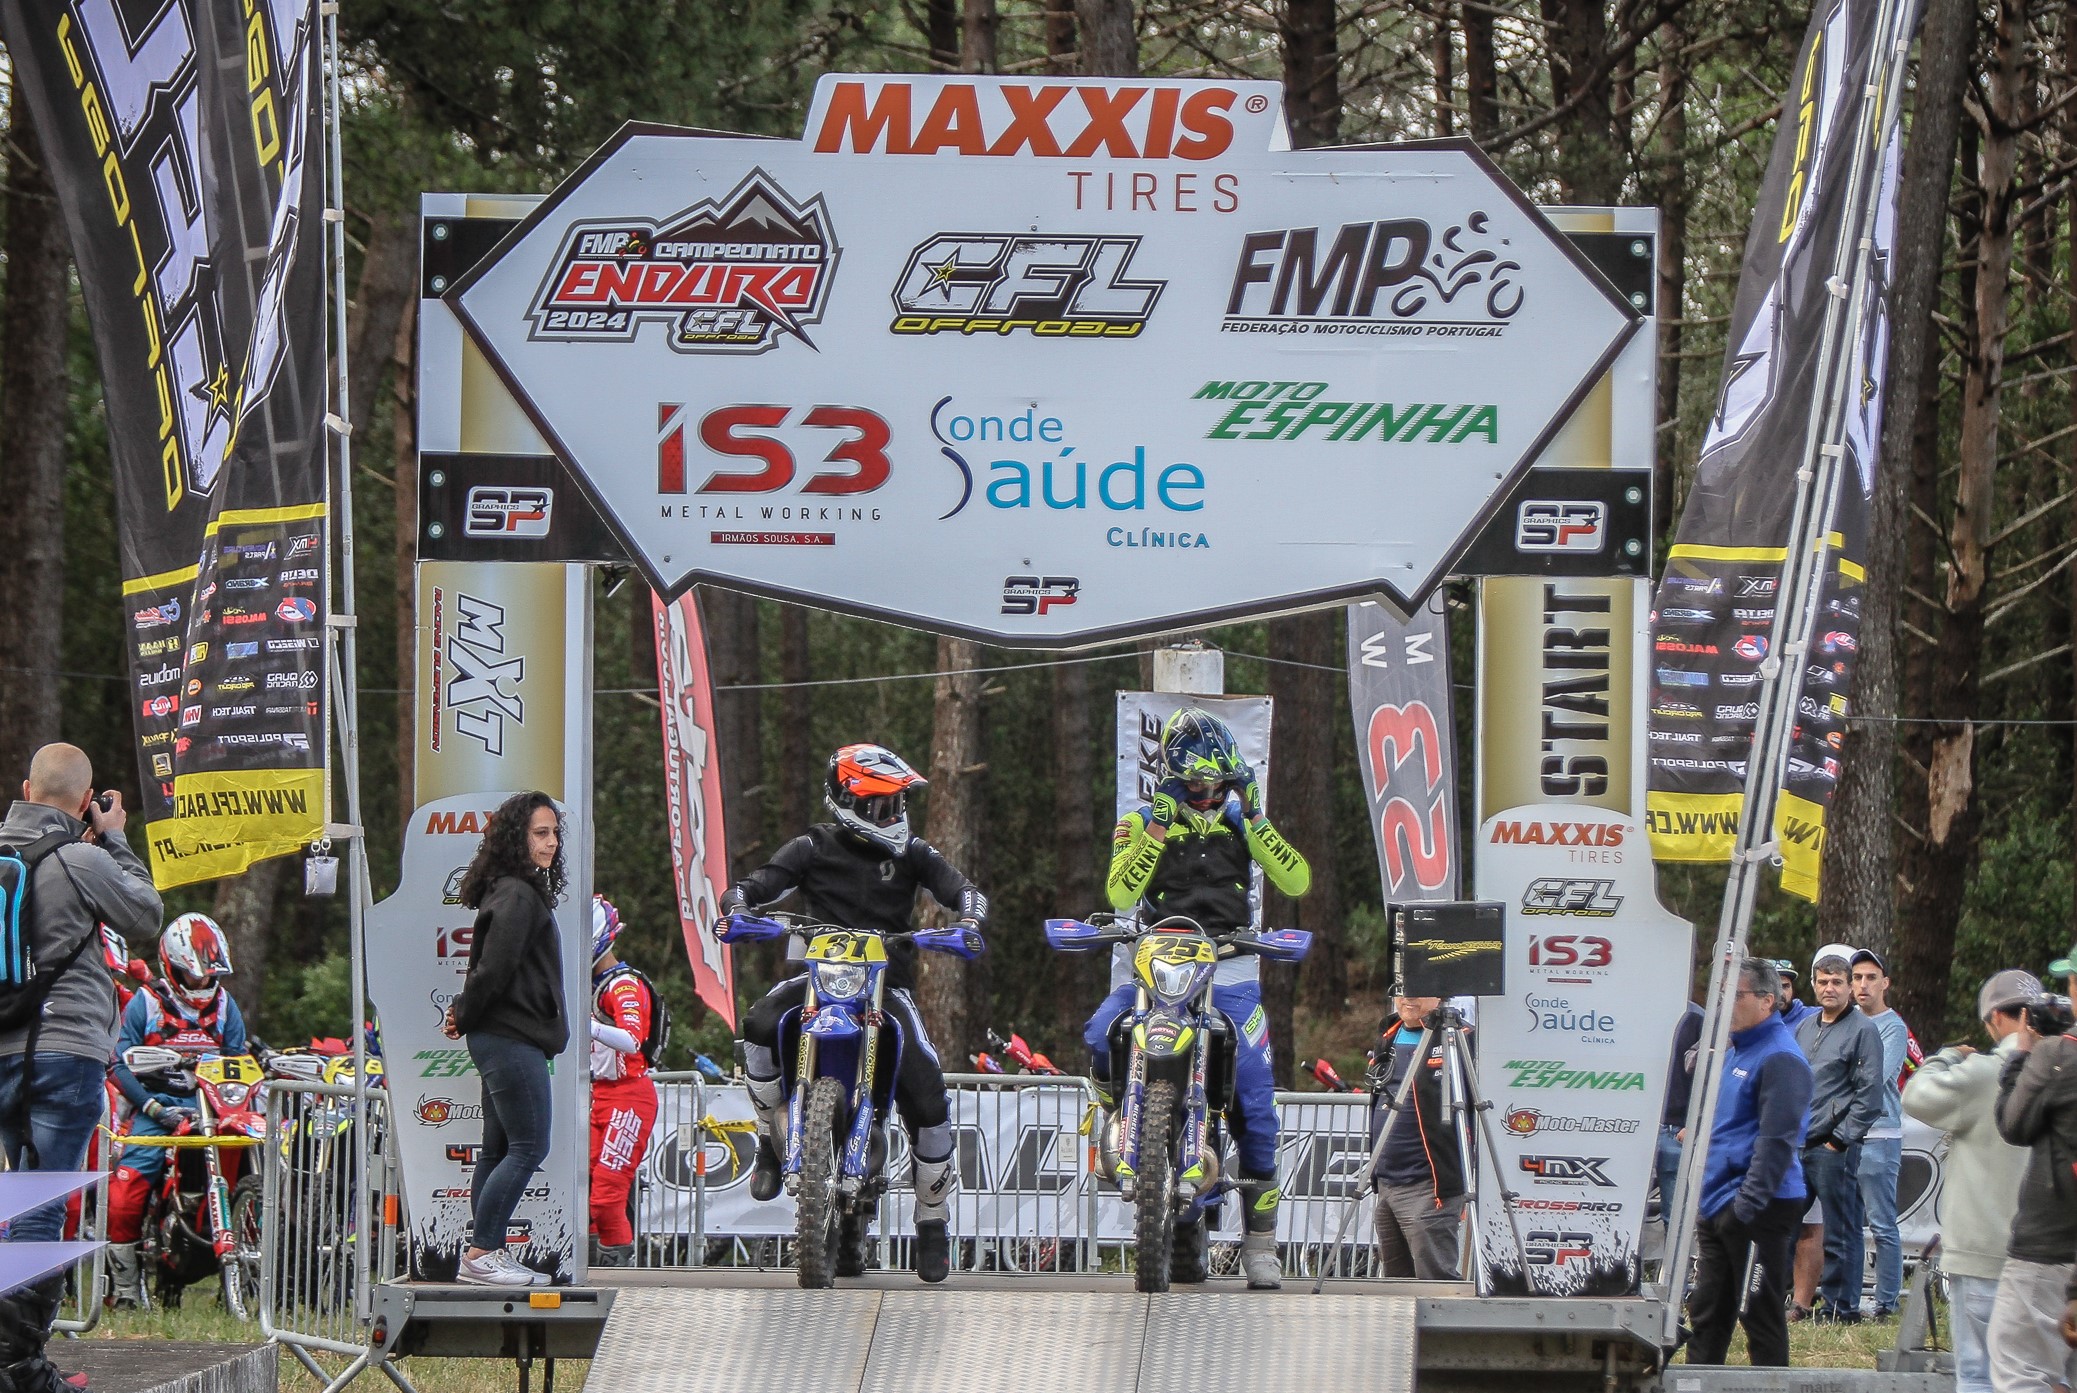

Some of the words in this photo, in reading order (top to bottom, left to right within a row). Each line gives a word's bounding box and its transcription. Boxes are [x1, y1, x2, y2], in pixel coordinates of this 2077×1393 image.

[1067, 171, 1239, 213] TIRES
[891, 232, 1168, 318] CFL
[1225, 217, 1432, 316] FMP
[551, 263, 822, 331] ENDURO
[550, 311, 627, 329] 2024
[684, 309, 765, 334] CFL
[1220, 320, 1310, 336] FEDERAÇÃO
[1313, 322, 1423, 336] MOTOCICLISMO
[1426, 324, 1503, 337] PORTUGAL
[1190, 380, 1329, 400] MOTO
[1203, 399, 1498, 443] ESPINHA
[471, 502, 520, 511] GRAPHICS
[661, 506, 745, 519] METAL
[761, 506, 882, 521] WORKING
[1523, 517, 1571, 526] GRAPHICS
[721, 532, 761, 544] IRMÃOS
[1003, 587, 1052, 596] GRAPHICS
[433, 586, 443, 648] RACING
[446, 591, 525, 757] MXT
[431, 648, 442, 752] SUSPENSION
[1544, 583, 1611, 797] START
[1257, 826, 1299, 872] KENNY
[1569, 850, 1623, 864] TIRES
[1122, 843, 1161, 892] KENNY
[1522, 878, 1625, 909] CFL
[826, 934, 870, 959] 31
[1152, 937, 1203, 957] 25
[223, 1059, 241, 1080] 6
[1503, 1060, 1566, 1069] MOTO
[1509, 1069, 1645, 1090] ESPINHA
[1130, 1104, 1139, 1140] MICHELIN
[1535, 1115, 1640, 1134] Moto-Master
